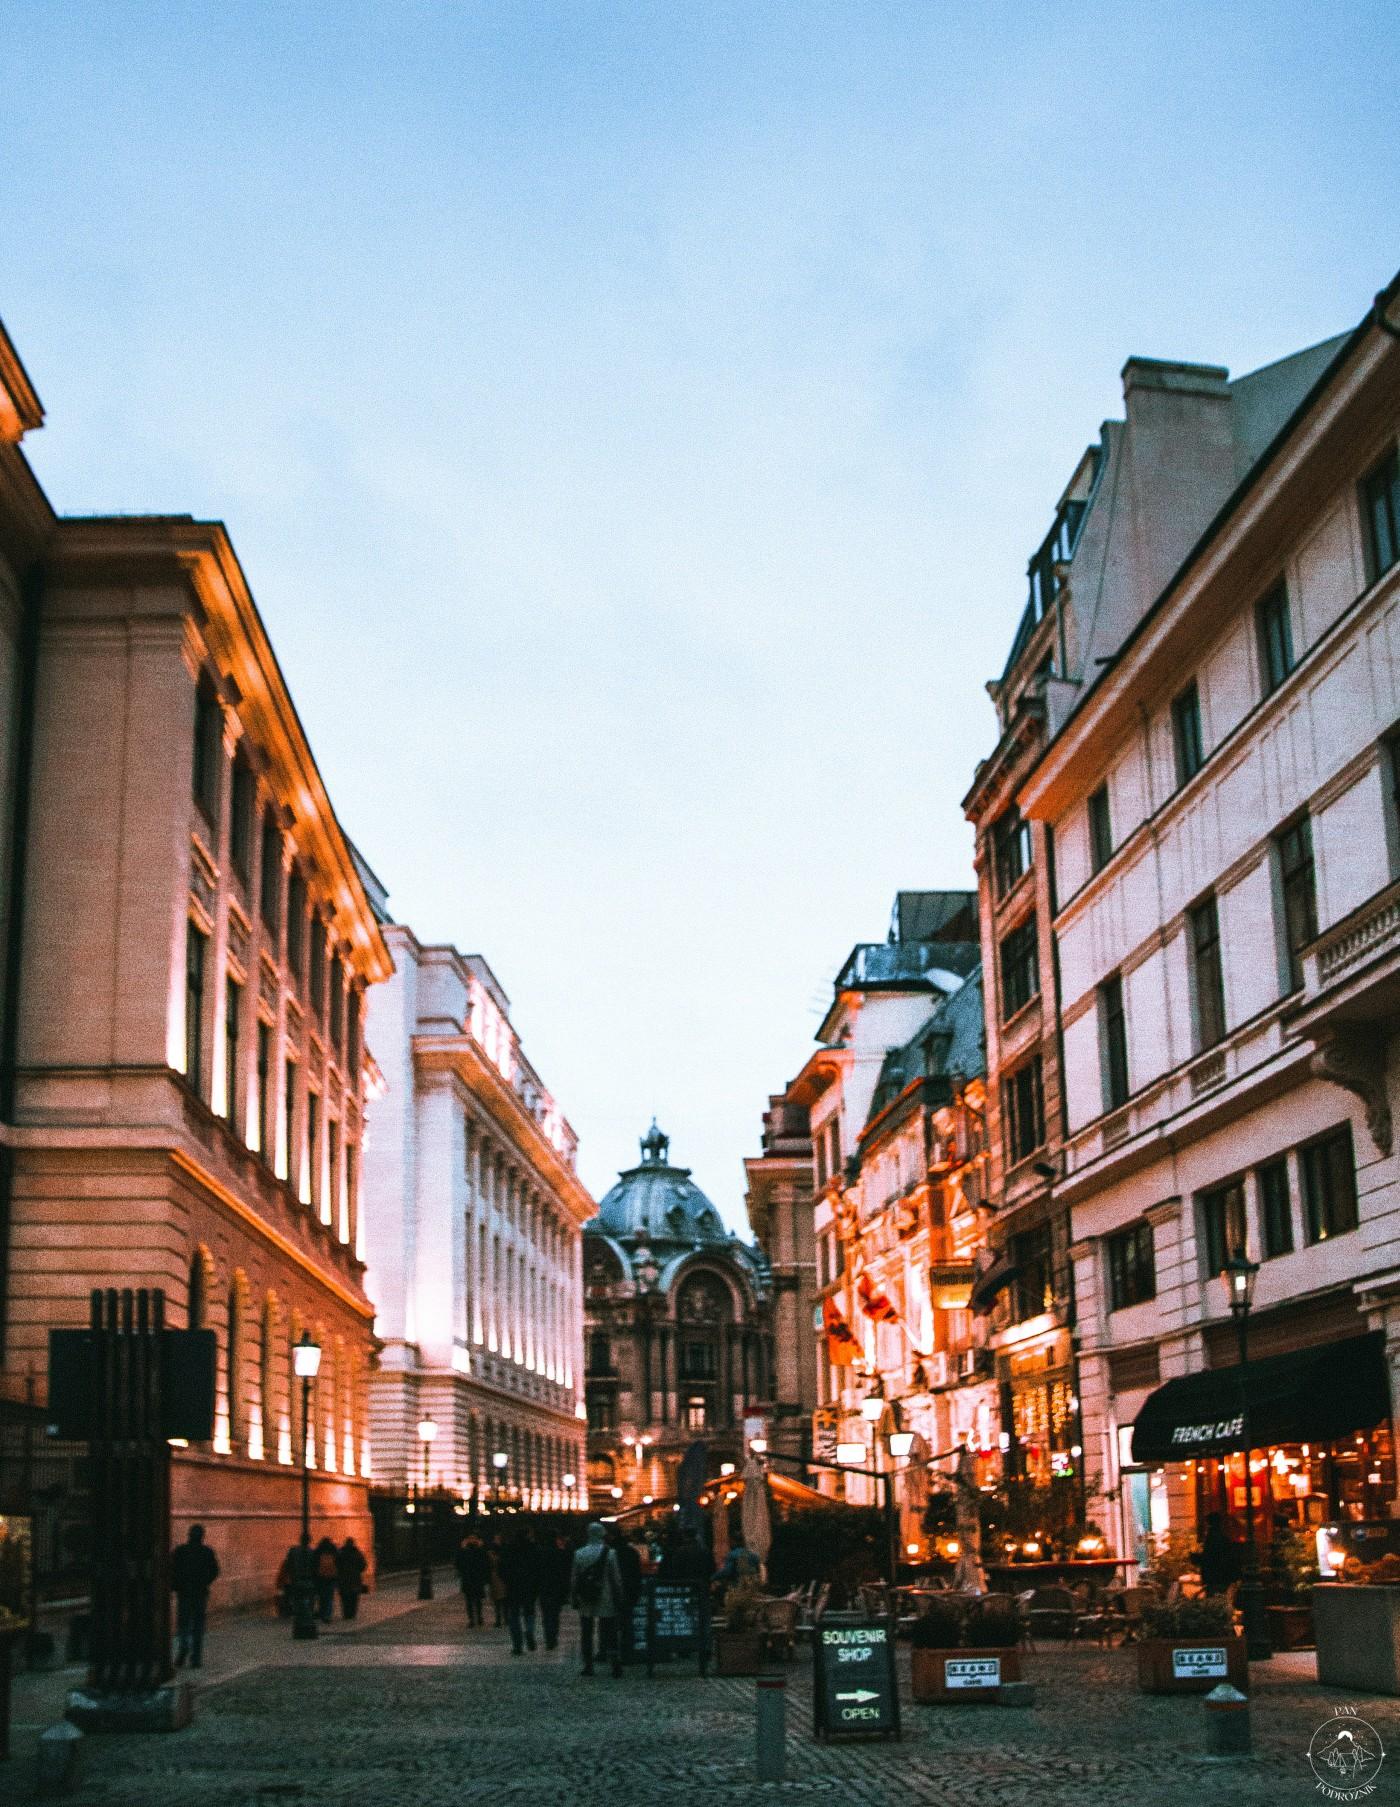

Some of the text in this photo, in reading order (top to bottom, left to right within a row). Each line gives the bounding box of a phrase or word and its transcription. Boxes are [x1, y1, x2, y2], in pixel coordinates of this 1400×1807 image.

[1171, 1424, 1215, 1443] FRENCH
[822, 1629, 887, 1644] SOUVENIR
[838, 1647, 872, 1662] SHOP
[841, 1708, 880, 1720] OPEN
